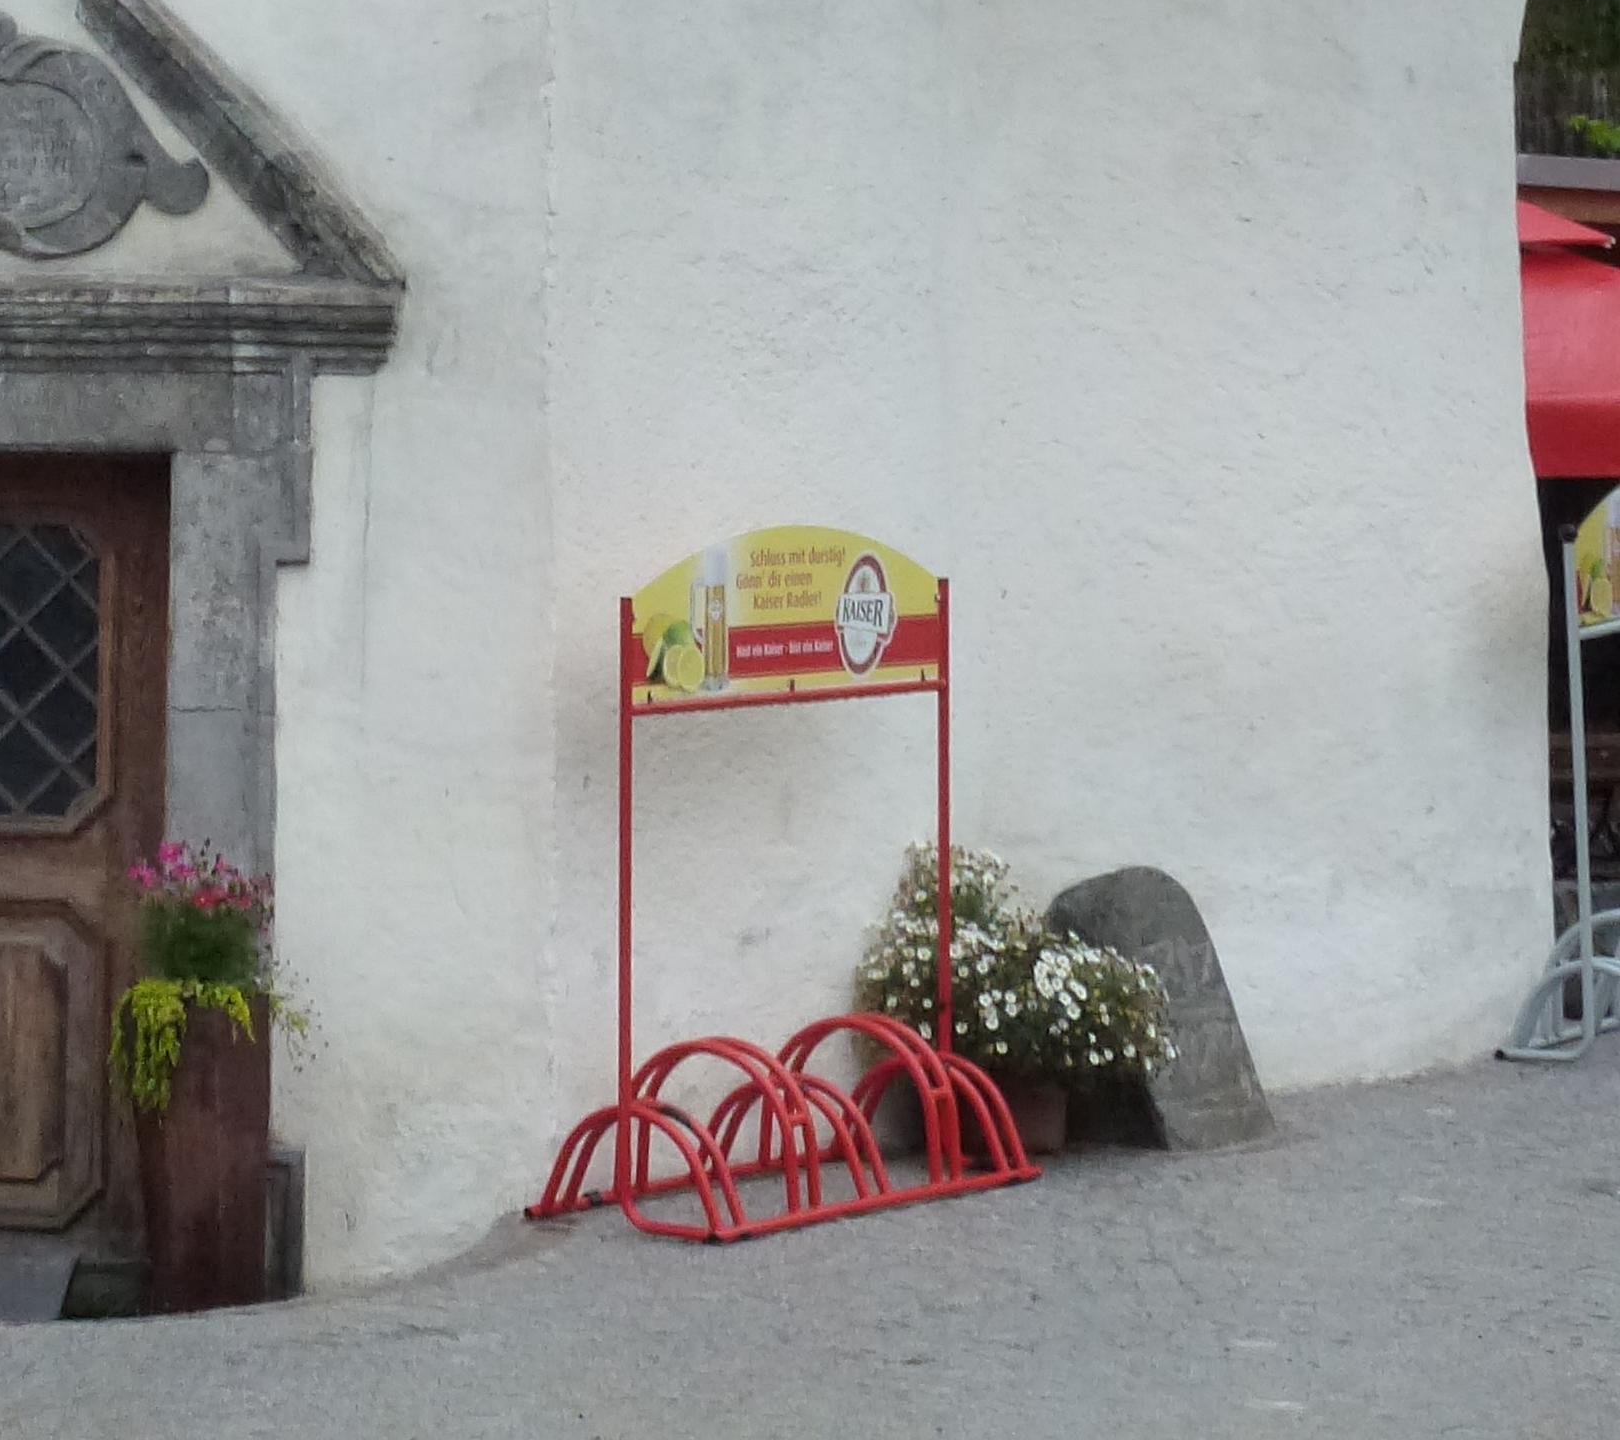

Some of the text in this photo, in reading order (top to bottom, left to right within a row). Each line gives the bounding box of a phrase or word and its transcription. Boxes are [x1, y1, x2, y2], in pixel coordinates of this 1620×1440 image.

[788, 550, 805, 565] mit
[753, 590, 821, 609] Kaiser Radler!
[842, 598, 884, 627] KAISER
